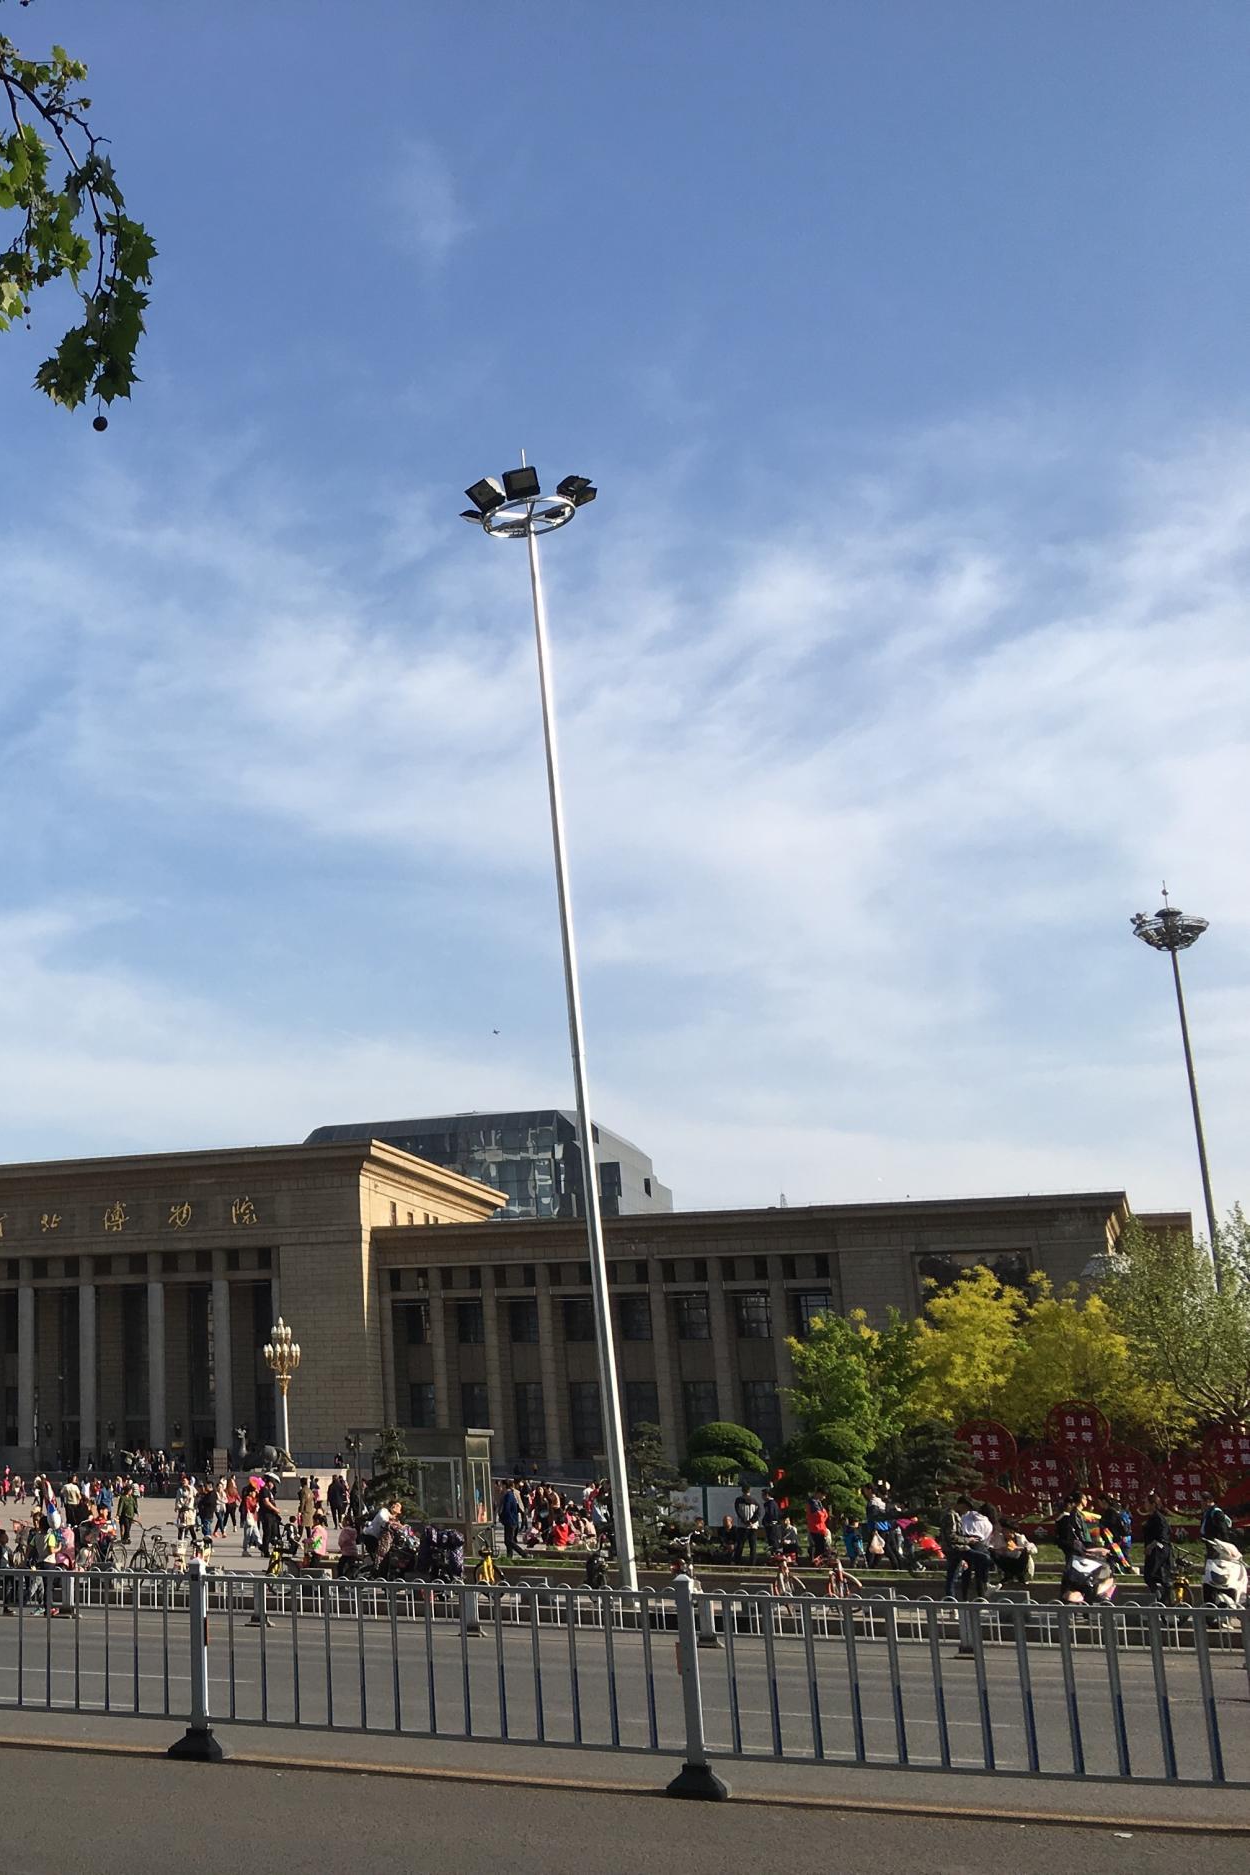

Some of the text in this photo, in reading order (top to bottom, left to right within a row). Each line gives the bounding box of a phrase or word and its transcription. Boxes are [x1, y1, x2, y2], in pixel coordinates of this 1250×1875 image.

[1064, 1415, 1092, 1427] 自由
[971, 1434, 999, 1446] 富强
[1065, 1431, 1094, 1443] 平等
[973, 1450, 1001, 1461] 民主
[1030, 1460, 1057, 1471] 文明
[1109, 1462, 1137, 1473] 公正
[1031, 1476, 1059, 1487] 和谐
[1110, 1478, 1139, 1489] 法治
[1172, 1474, 1202, 1486] 爱国
